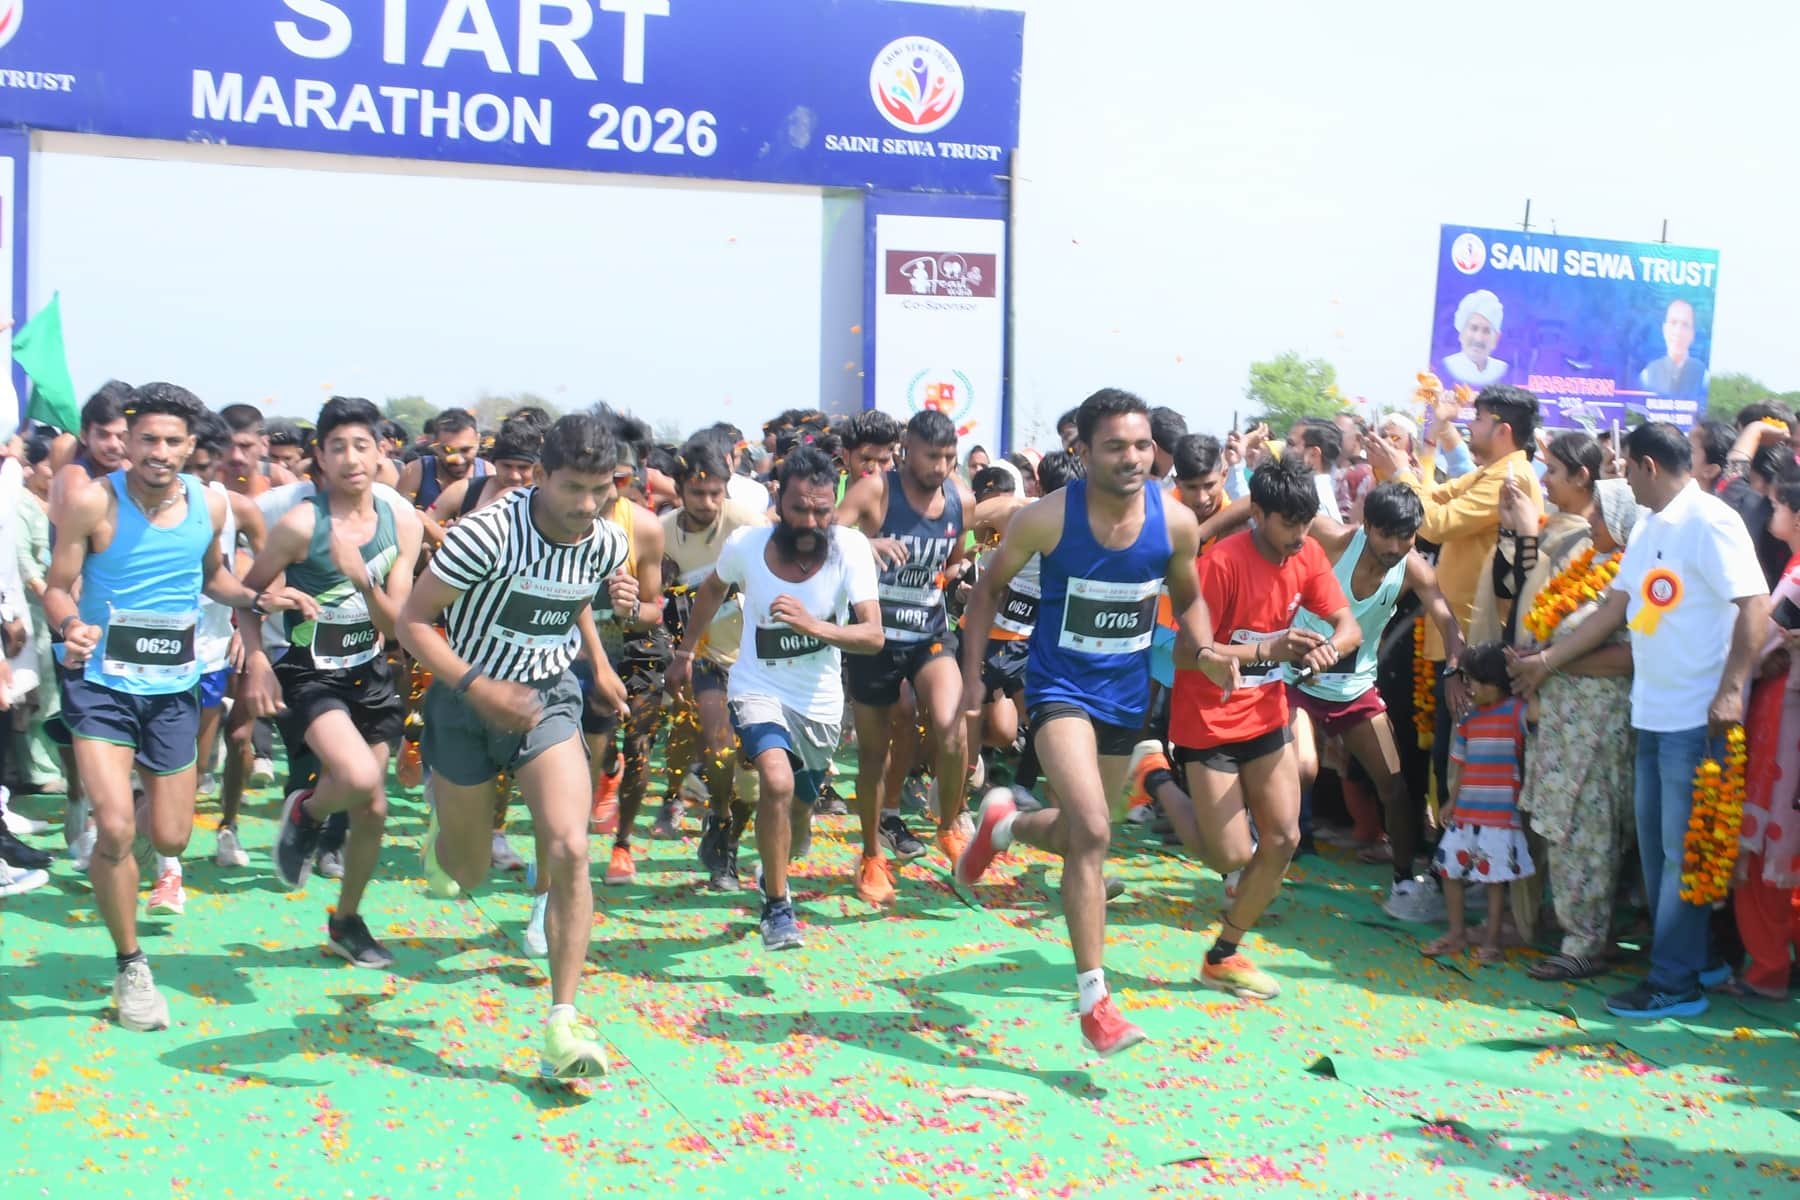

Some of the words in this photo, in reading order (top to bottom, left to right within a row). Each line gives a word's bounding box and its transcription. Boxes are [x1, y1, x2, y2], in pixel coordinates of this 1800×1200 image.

[274, 0, 671, 84] START
[192, 69, 552, 145] MARATHON
[587, 103, 718, 156] 2026
[825, 134, 879, 154] SAINI
[882, 138, 935, 158] SEWA
[940, 143, 1002, 161] TRUST
[1489, 243, 1558, 274] SAINI
[1563, 249, 1635, 280] SEWA
[1640, 256, 1716, 287] TRUST
[1528, 375, 1615, 397] MARATHON
[529, 609, 570, 626] 1008
[1094, 611, 1140, 630] 0705
[136, 637, 182, 654] 0629
[342, 629, 375, 648] 0905
